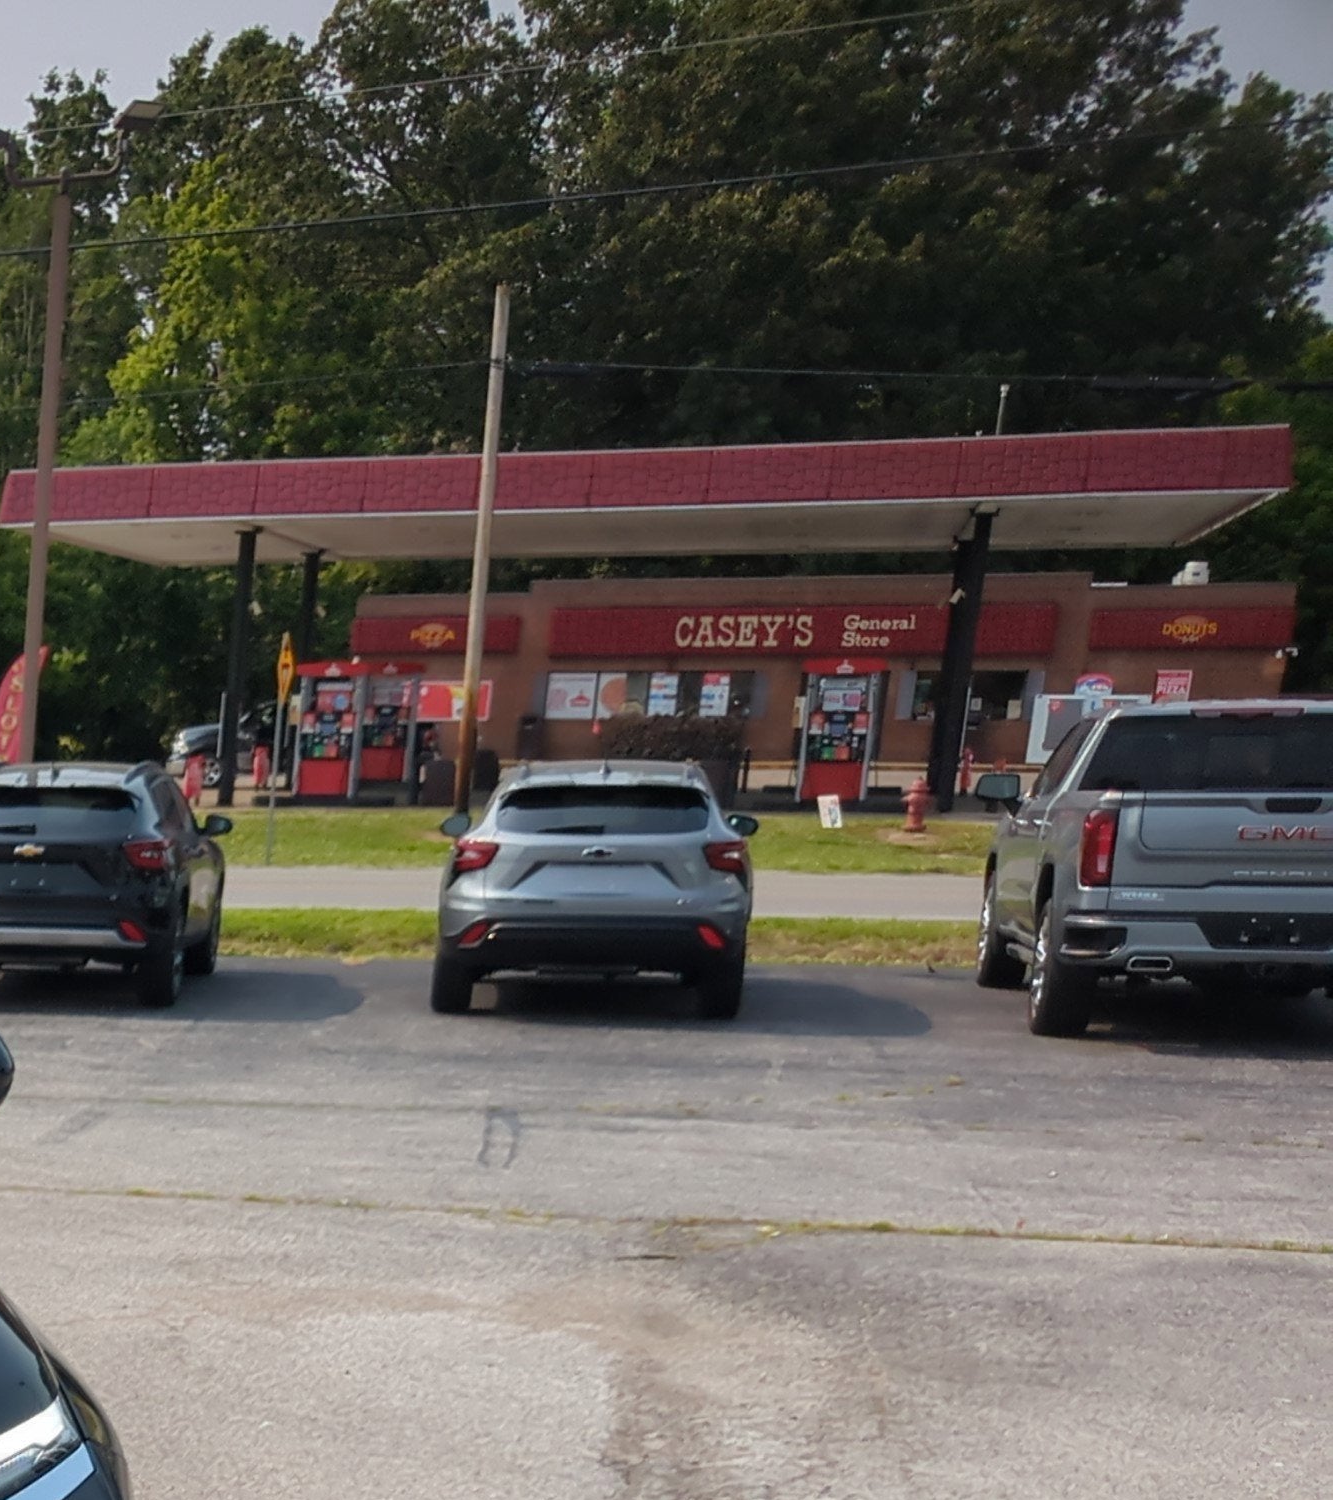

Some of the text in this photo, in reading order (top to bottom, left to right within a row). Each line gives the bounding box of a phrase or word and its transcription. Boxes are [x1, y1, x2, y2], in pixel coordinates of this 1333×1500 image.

[843, 614, 917, 630] General
[1162, 622, 1218, 636] DONUTS
[410, 629, 455, 643] PIZZA
[674, 614, 814, 647] CASEY'S
[841, 631, 891, 647] Store
[1237, 825, 1333, 841] GMC
